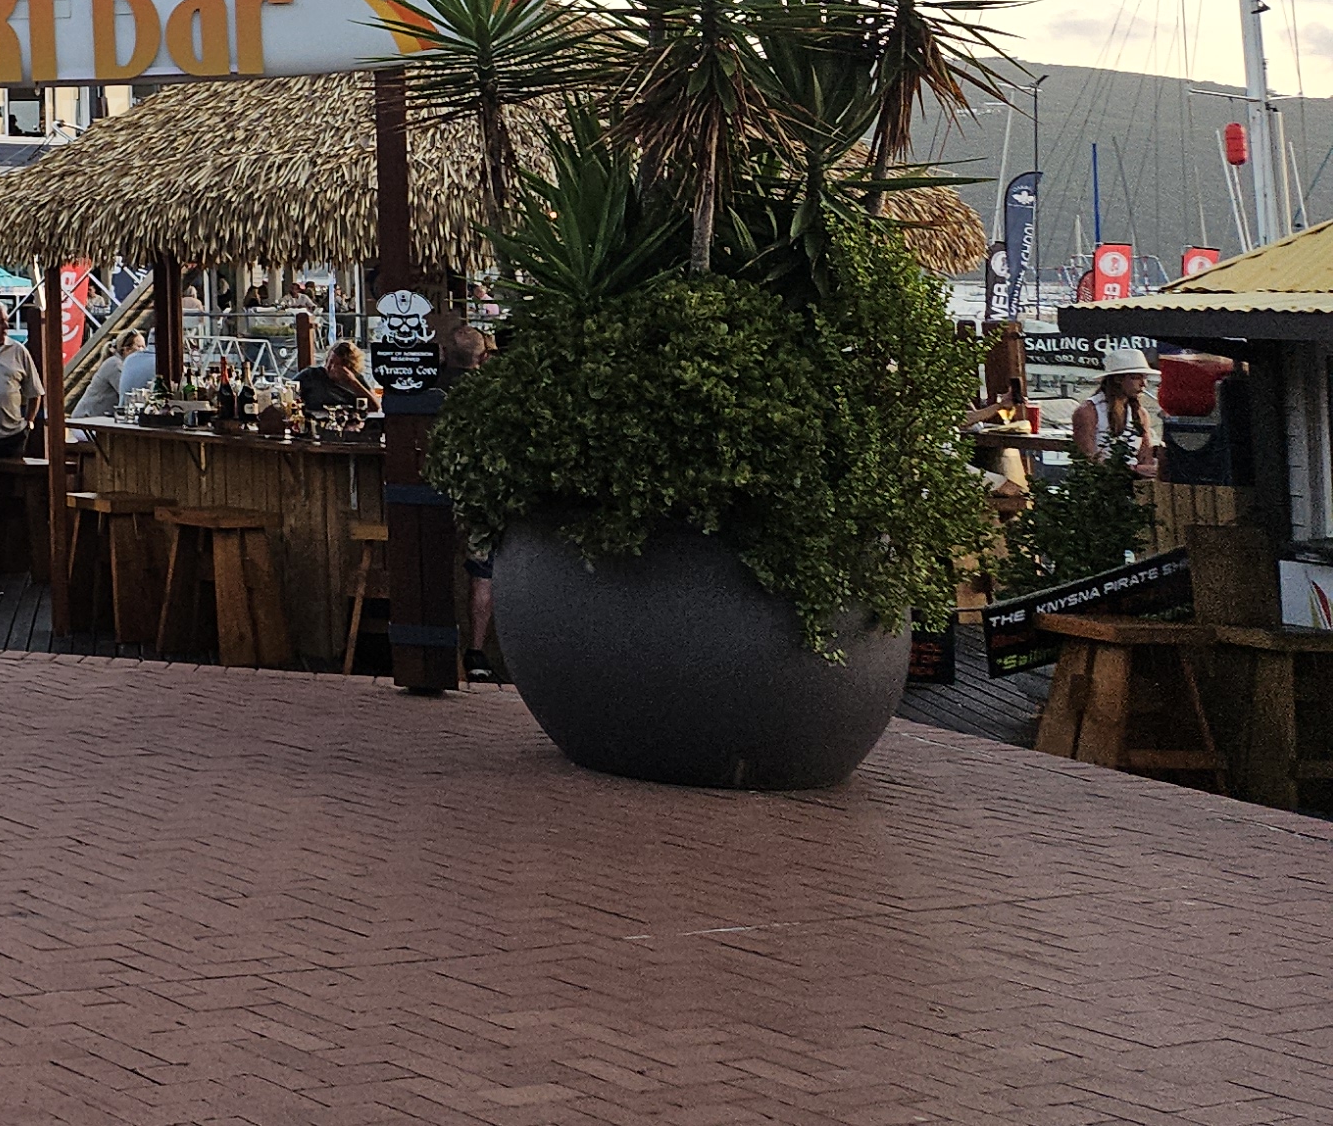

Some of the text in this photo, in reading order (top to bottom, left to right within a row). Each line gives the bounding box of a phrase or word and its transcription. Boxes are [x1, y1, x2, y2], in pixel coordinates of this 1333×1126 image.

[1025, 337, 1089, 352] SAILING
[989, 610, 1026, 627] THE
[1035, 586, 1101, 616] KNYSNA
[1103, 568, 1159, 595] PIRATE
